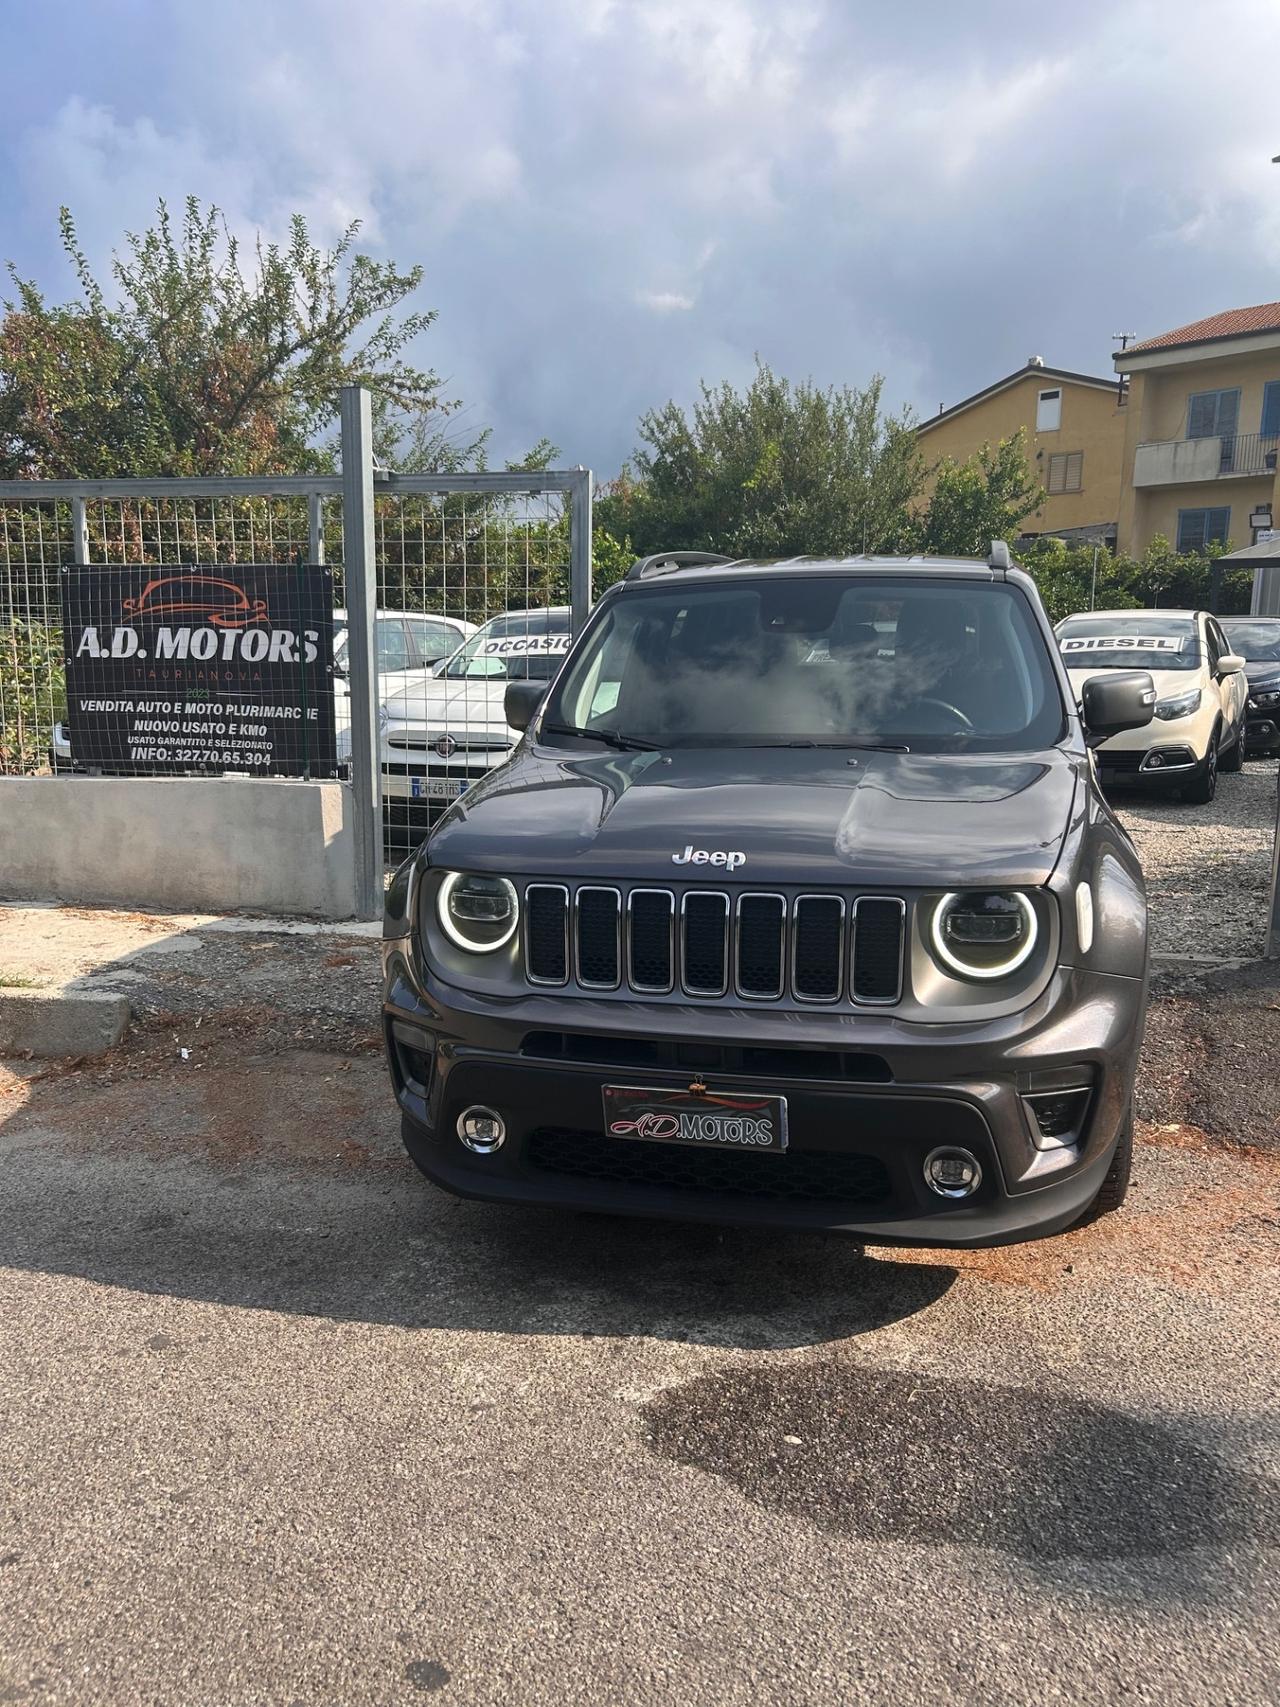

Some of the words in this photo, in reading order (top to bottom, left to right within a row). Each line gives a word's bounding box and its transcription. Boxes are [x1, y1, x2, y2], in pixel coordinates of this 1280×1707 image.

[76, 627, 147, 659] A.D.
[155, 627, 319, 664] MOTORS
[1066, 638, 1174, 650] DIESEL
[136, 668, 262, 681] TAURIANOVA
[80, 700, 134, 712] VENDITA
[136, 701, 171, 713] AUTO
[174, 702, 182, 714] E
[184, 703, 223, 715] MOTO
[134, 720, 180, 733] NUOVO
[182, 721, 226, 734] USATO
[228, 723, 238, 735] E
[127, 736, 156, 745] USATO
[157, 737, 207, 747] GARANTITO
[208, 738, 214, 747] E
[214, 740, 274, 751] SELEZIONATO
[131, 747, 172, 761] INFO:
[671, 845, 747, 872] Jeep
